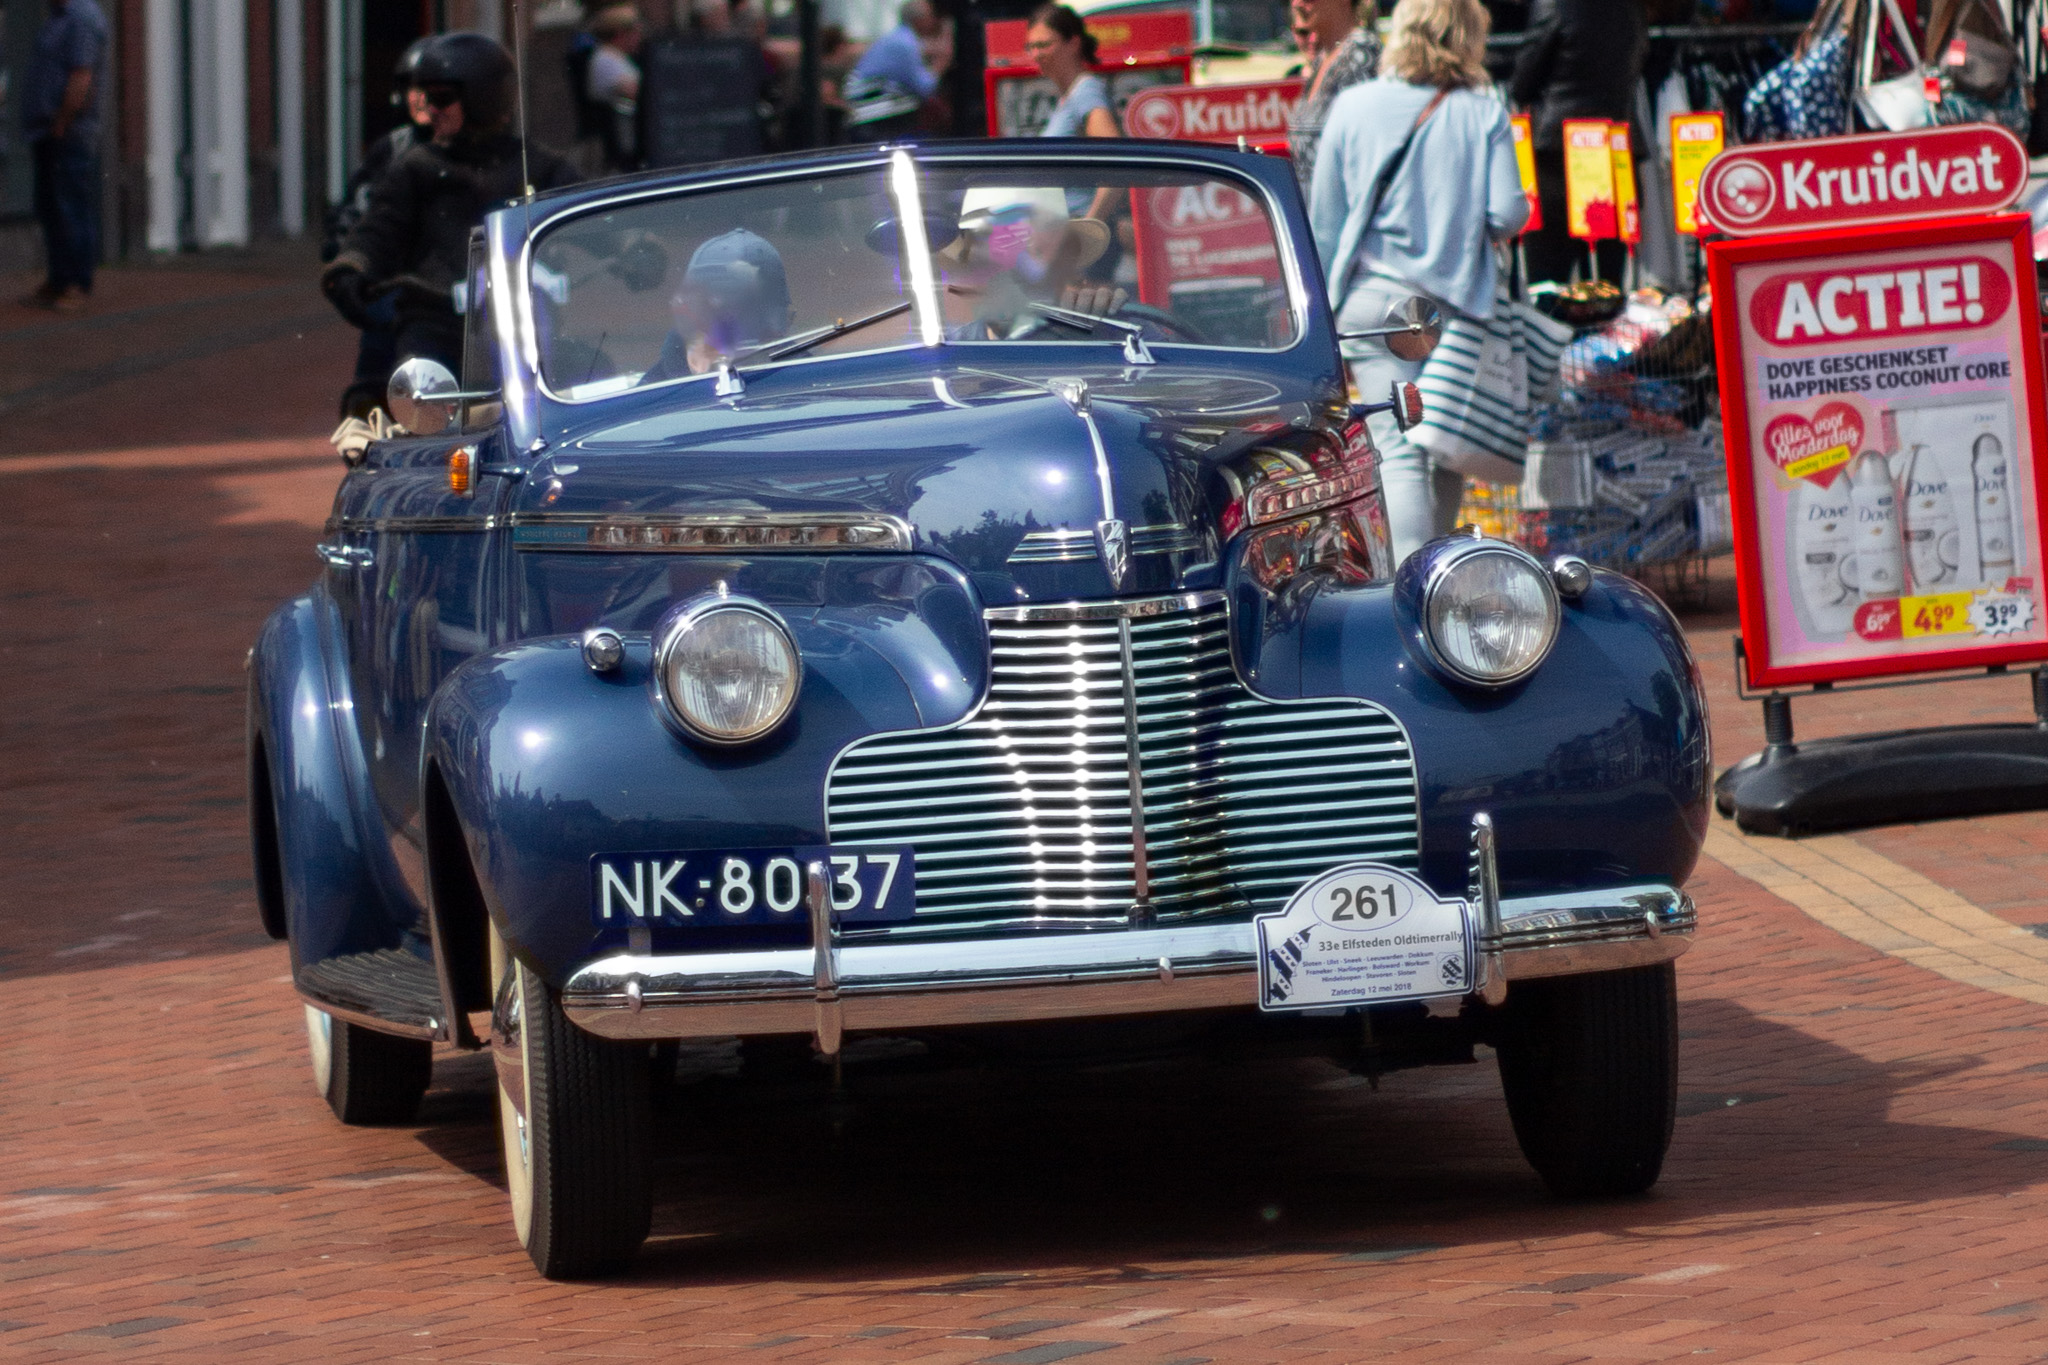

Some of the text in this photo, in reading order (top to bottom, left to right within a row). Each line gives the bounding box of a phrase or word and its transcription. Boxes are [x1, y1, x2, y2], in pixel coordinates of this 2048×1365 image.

[1183, 90, 1304, 134] Kruidv
[1781, 145, 2004, 211] Kruidvat
[1775, 263, 1985, 340] ACTIE!
[1766, 346, 1949, 380] DOVE GESCHENKSET
[1768, 360, 2012, 400] HAPPINESS COCONUT CORE
[1909, 480, 1948, 497] Dove
[1808, 503, 1849, 521] Dove
[601, 854, 901, 919] NK-8037
[1330, 883, 1398, 922] 261
[1318, 930, 1464, 952] 33e Elfsteden Oldtimerrally
[1367, 954, 1404, 962] Leeuwarden
[1408, 951, 1434, 959] Dokkum
[1331, 982, 1412, 997] Zaterdag 12 mei 2018
